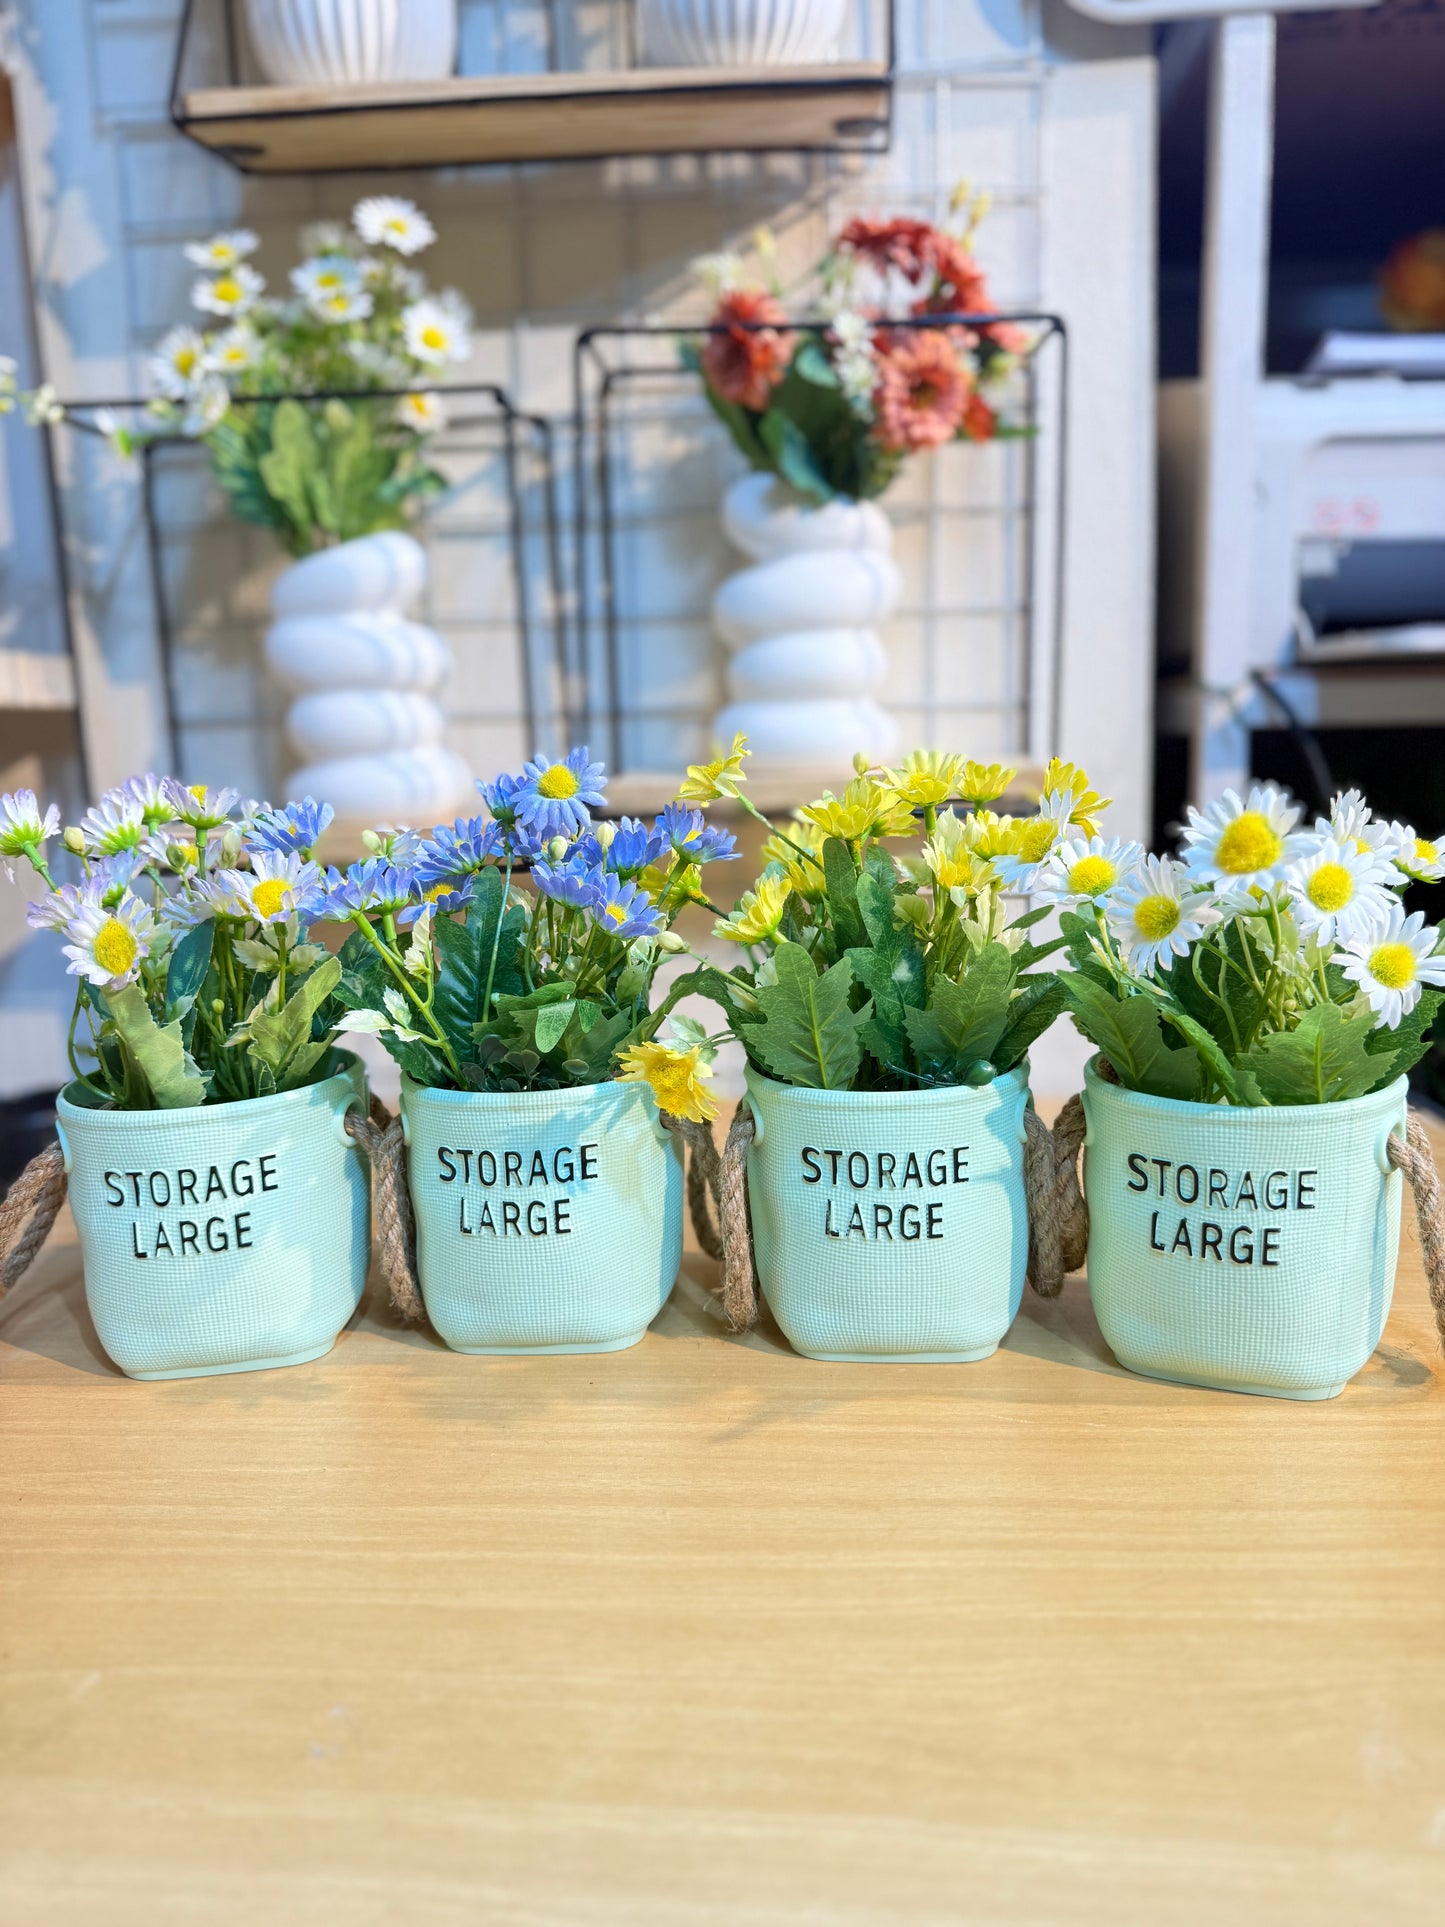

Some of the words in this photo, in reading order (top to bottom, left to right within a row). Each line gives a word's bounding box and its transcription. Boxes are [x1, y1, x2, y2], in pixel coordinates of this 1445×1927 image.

[104, 1154, 280, 1208] STORAGE
[438, 1144, 599, 1186] STORAGE
[801, 1146, 970, 1188] STORAGE
[1128, 1152, 1318, 1211] STORAGE
[131, 1212, 253, 1259] LARGE
[460, 1198, 572, 1236] LARGE
[825, 1200, 944, 1240] LARGE
[1150, 1210, 1281, 1266] LARGE
